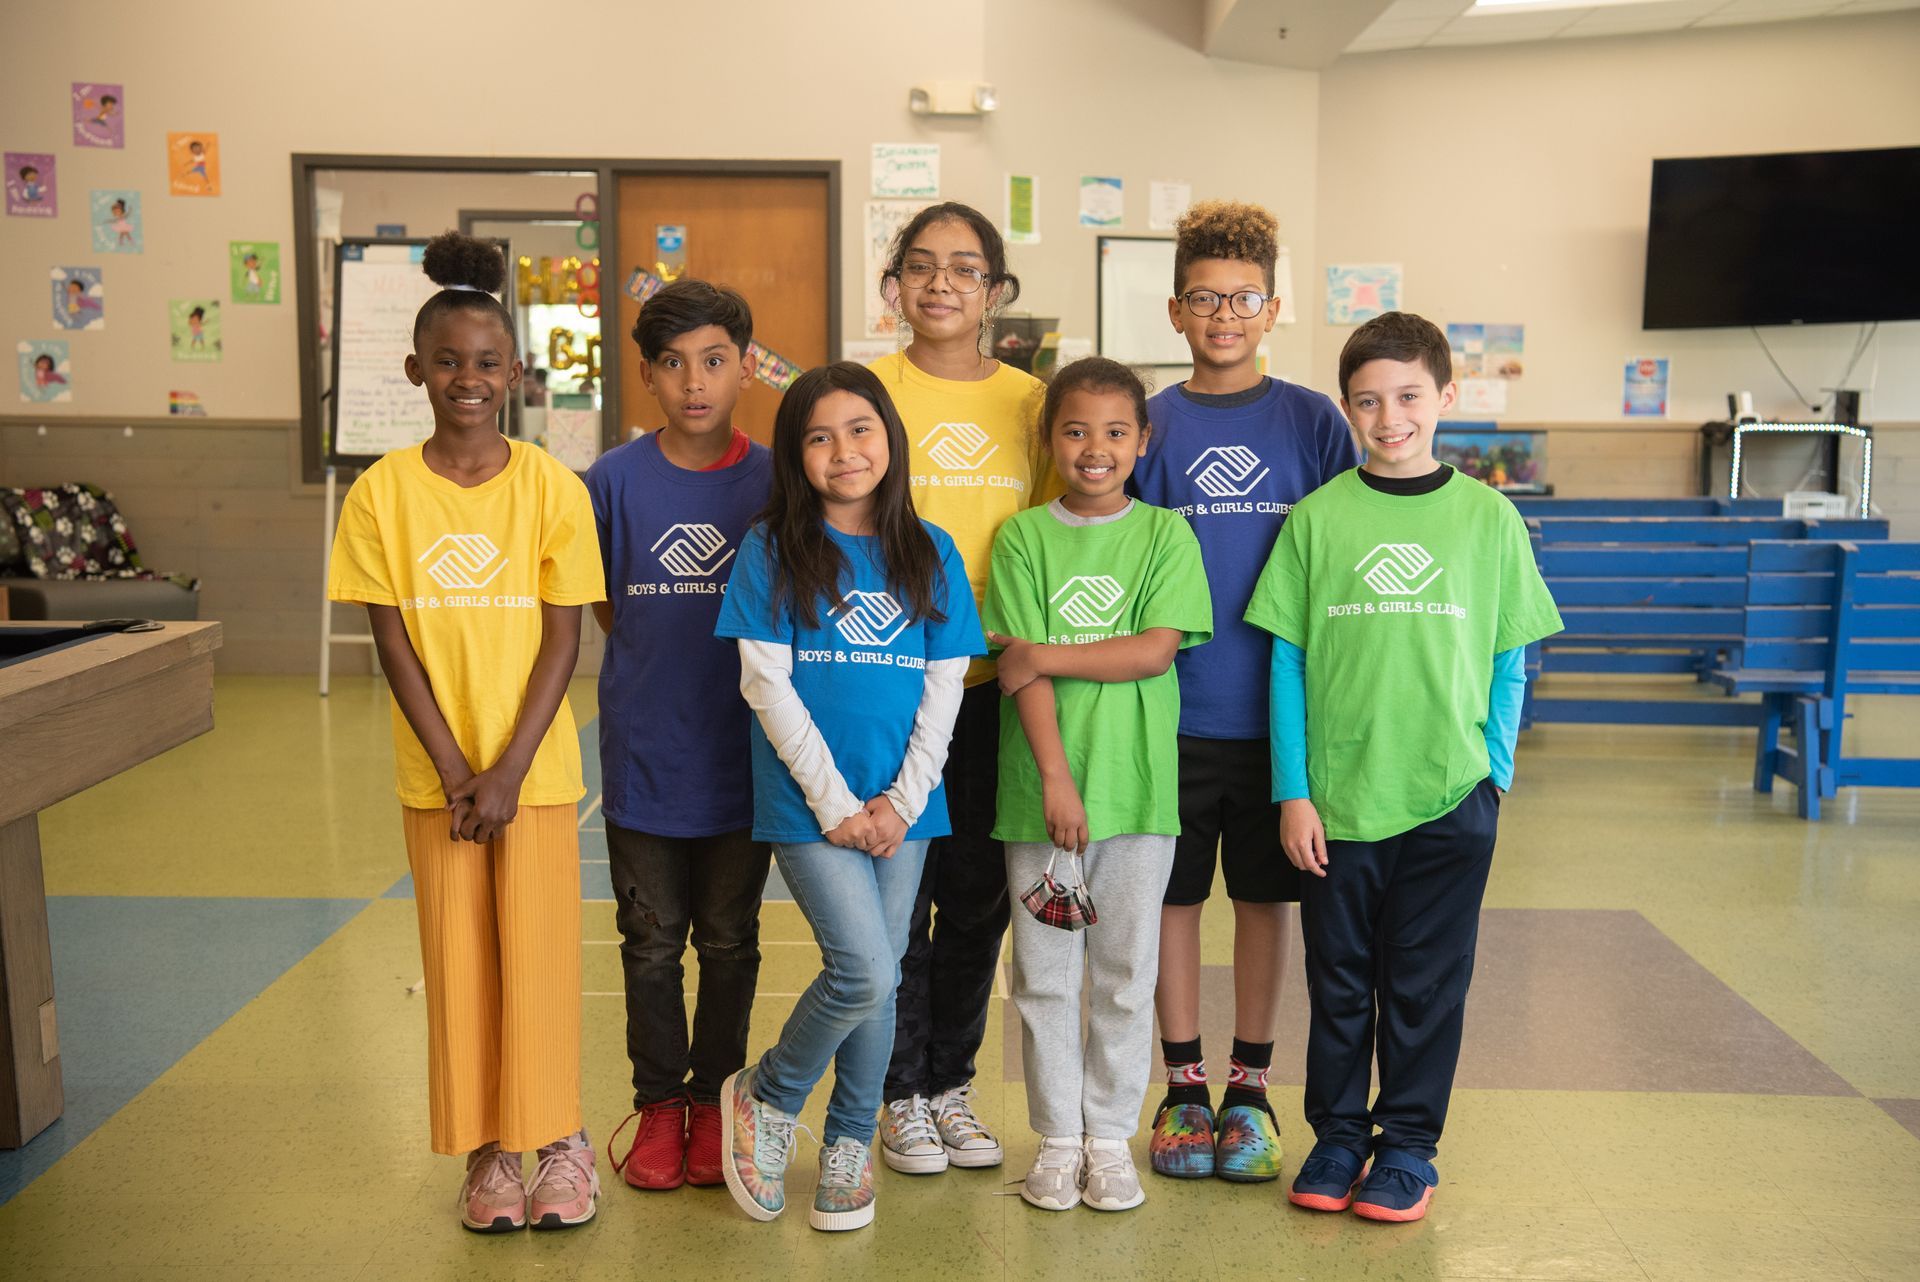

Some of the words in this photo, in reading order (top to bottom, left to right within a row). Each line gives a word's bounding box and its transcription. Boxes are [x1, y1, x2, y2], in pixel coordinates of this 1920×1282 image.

[930, 475, 942, 487] &
[944, 475, 984, 487] GIRLS
[988, 475, 1025, 492] CLUBS
[1196, 503, 1209, 515] &
[1211, 502, 1253, 514] GIRLS
[627, 583, 657, 596] BOYS
[659, 583, 671, 595] &
[673, 582, 717, 594] GIRLS
[428, 596, 441, 609] &
[444, 595, 490, 608] GIRLS
[493, 595, 536, 609] CLUBS
[1327, 603, 1361, 617] BOYS
[1364, 602, 1376, 614] &
[1379, 601, 1424, 613] GIRLS
[1427, 602, 1466, 619] CLUBS
[798, 650, 832, 662] BOYS
[835, 650, 848, 663] &
[850, 651, 893, 665] GIRLS
